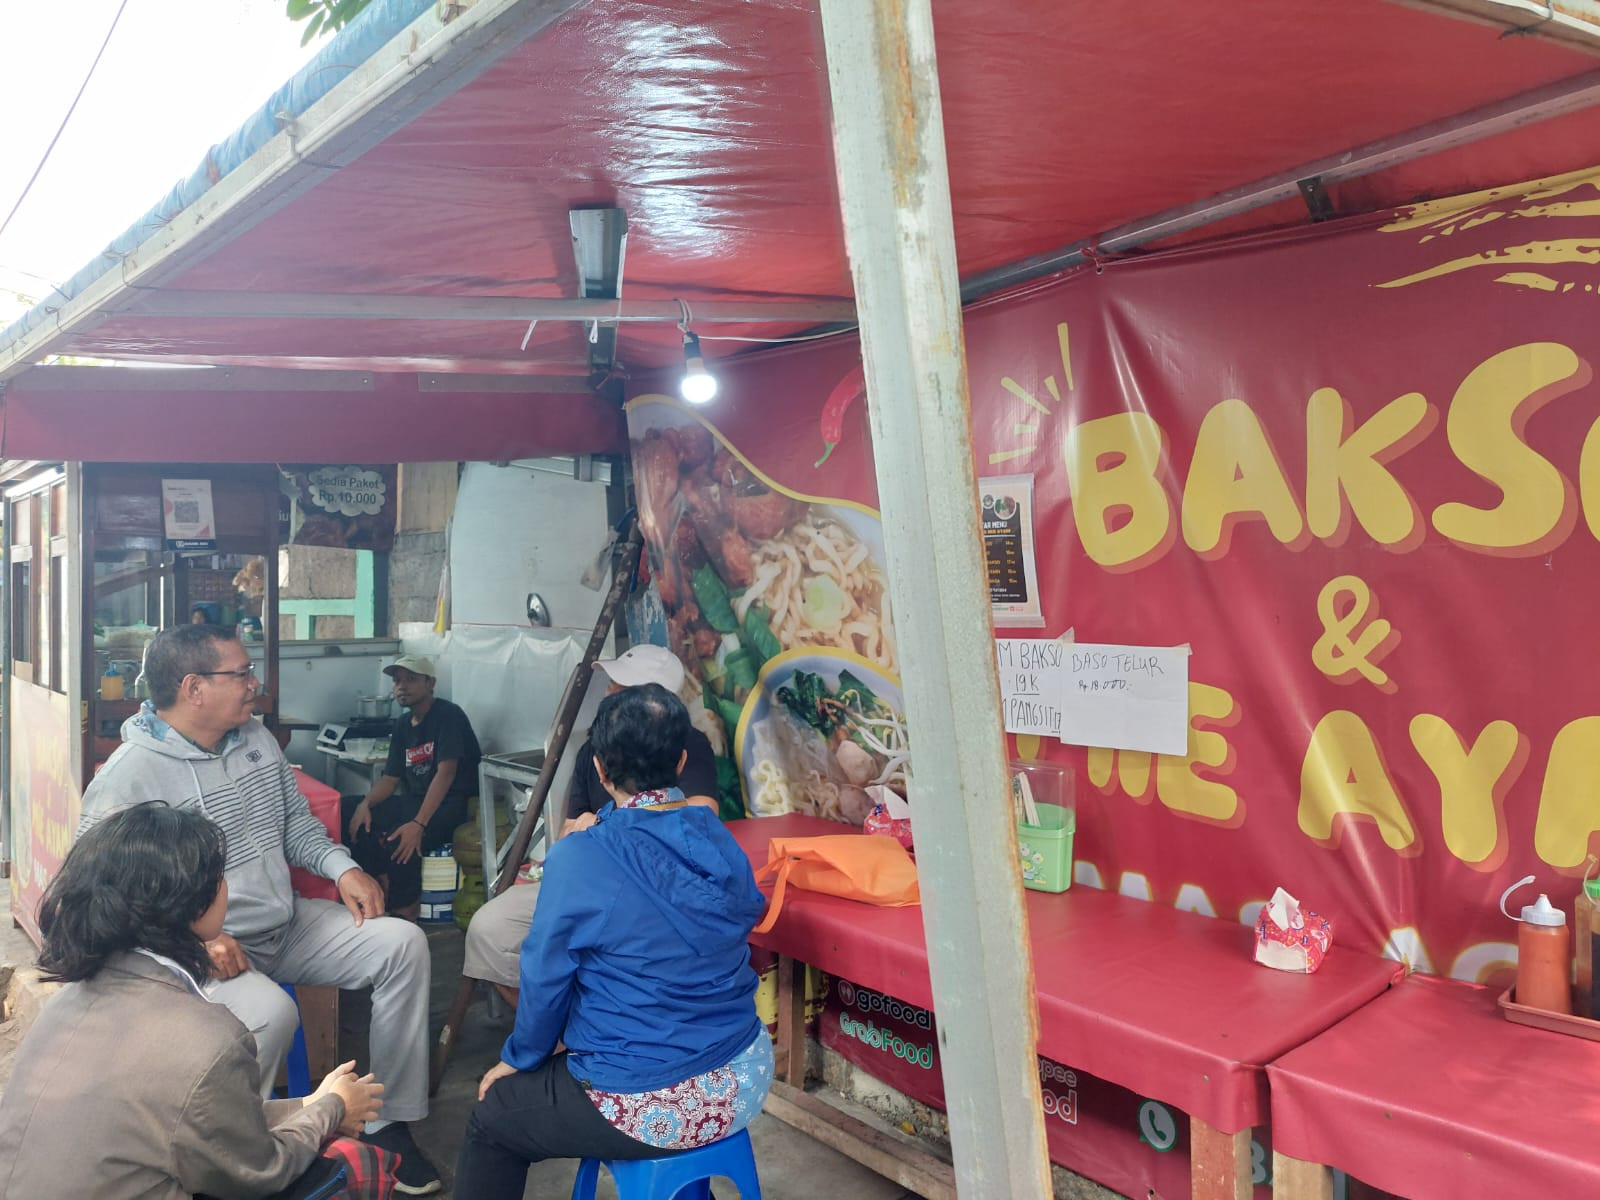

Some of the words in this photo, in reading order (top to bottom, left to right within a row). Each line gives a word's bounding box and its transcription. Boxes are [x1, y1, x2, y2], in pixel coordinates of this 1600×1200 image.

[349, 477, 379, 489] Paket
[1312, 575, 1391, 686] &
[1019, 641, 1064, 670] BAKSO
[1072, 652, 1108, 673] BASO
[1111, 653, 1165, 678] TELUR
[857, 989, 931, 1031] gofood
[839, 1012, 933, 1070] GrabFood
[1039, 1058, 1077, 1088] pee
[1042, 1088, 1077, 1125] od
